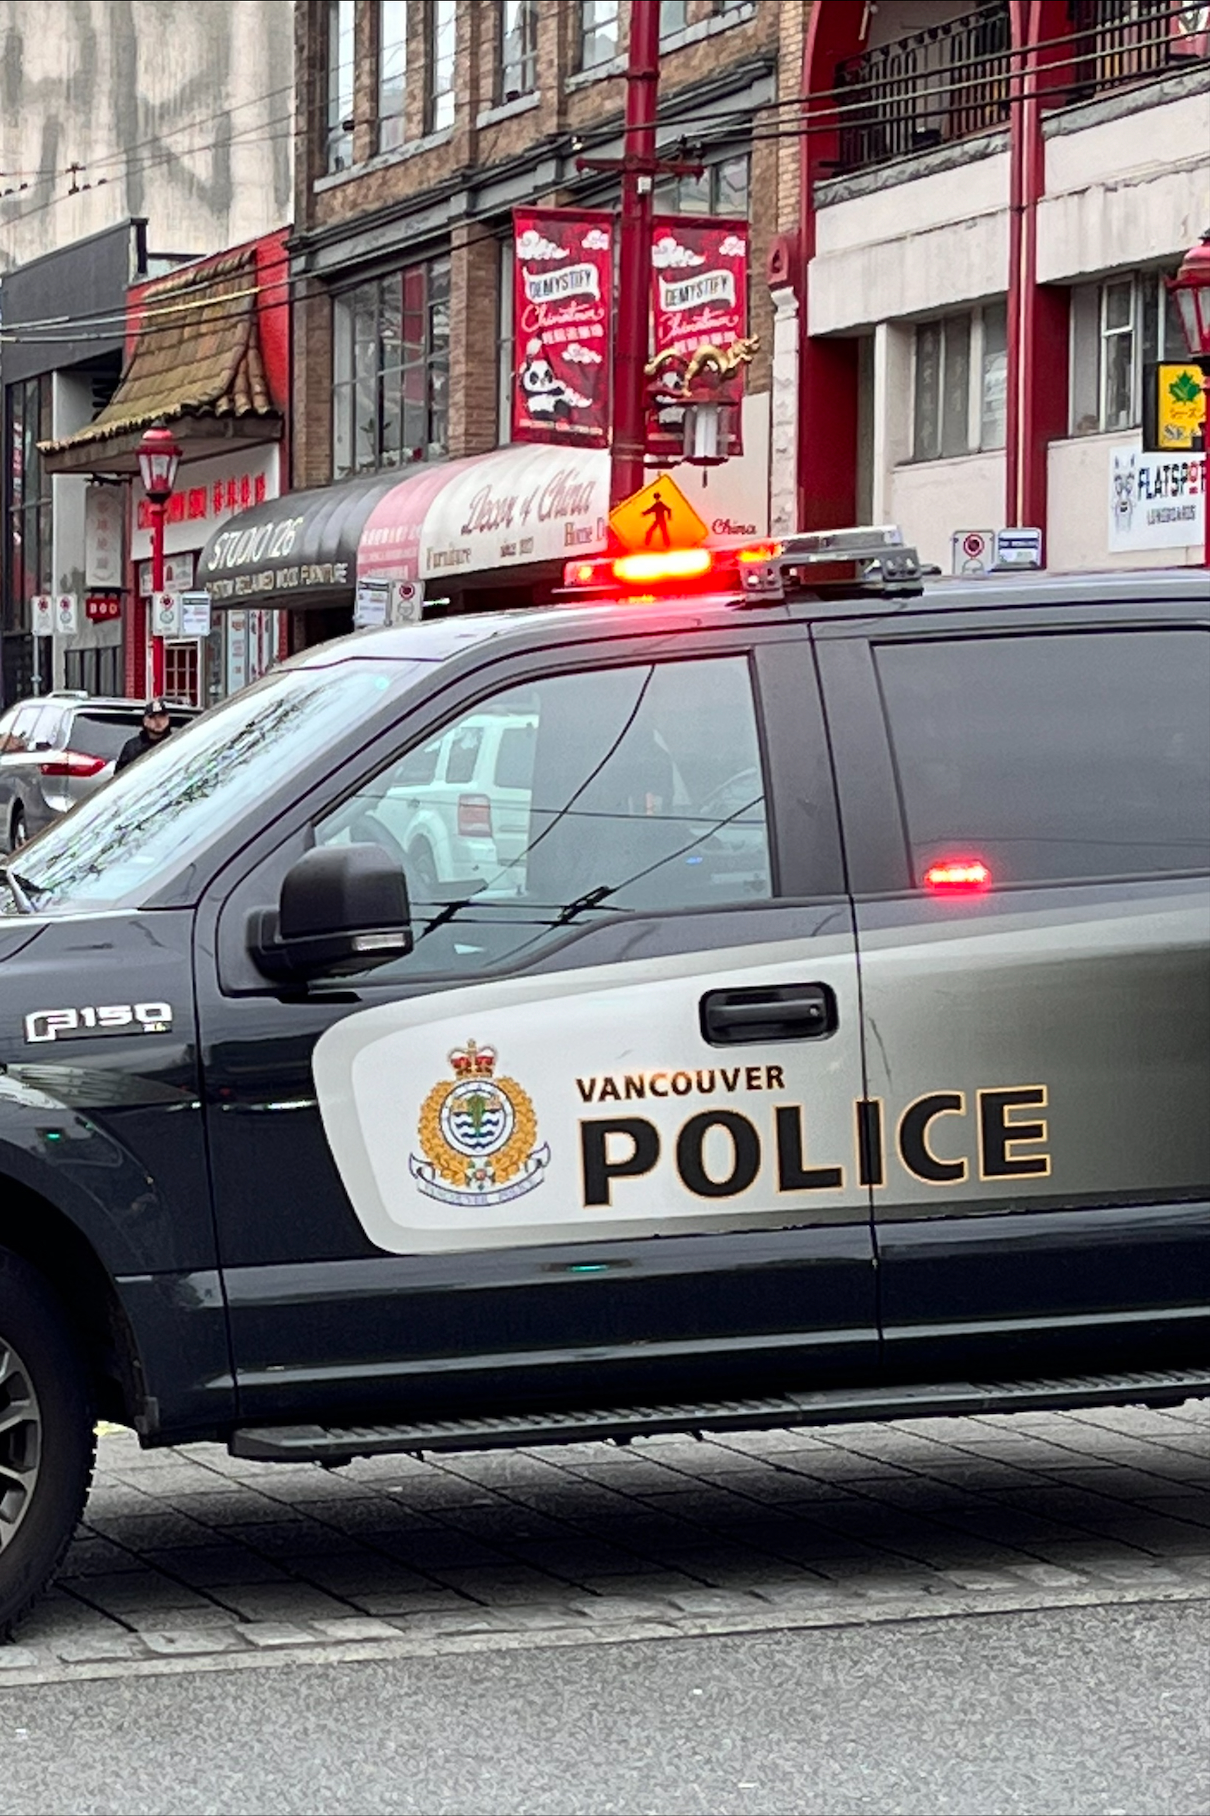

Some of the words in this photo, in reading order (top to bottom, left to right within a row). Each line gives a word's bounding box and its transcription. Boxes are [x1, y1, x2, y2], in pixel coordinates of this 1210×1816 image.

[529, 268, 593, 299] DEMYSTIFY
[665, 275, 728, 308] DEMYSTIFY
[538, 467, 597, 523] China
[207, 521, 274, 572] STUDIO
[267, 516, 305, 558] 126
[711, 518, 757, 535] China
[575, 1065, 785, 1102] VANCOUVER
[578, 1084, 1052, 1209] POLICE
